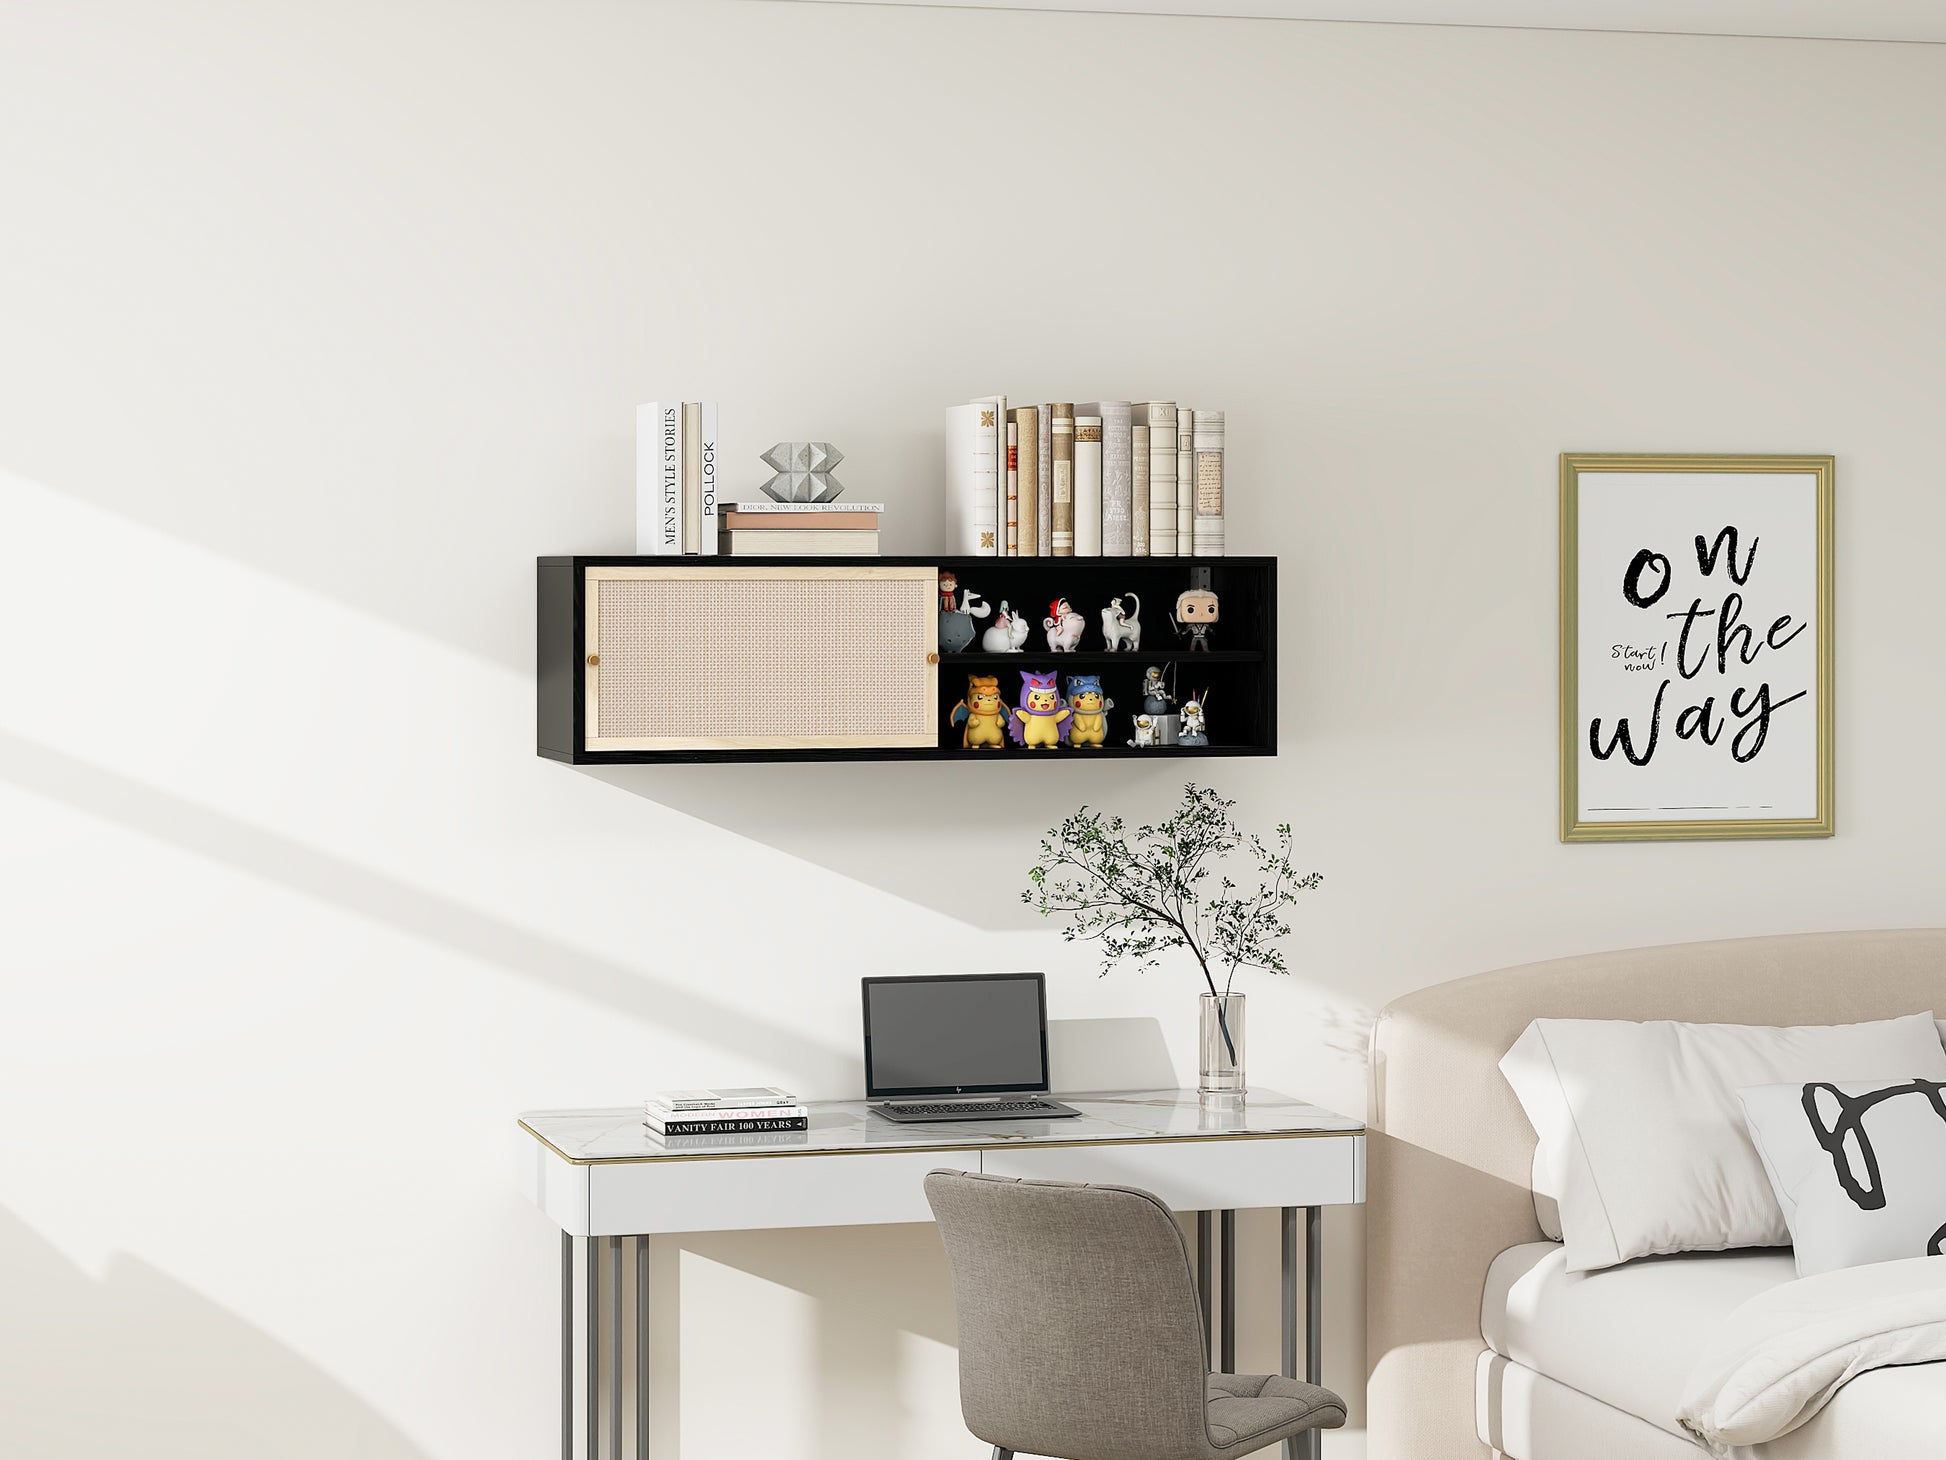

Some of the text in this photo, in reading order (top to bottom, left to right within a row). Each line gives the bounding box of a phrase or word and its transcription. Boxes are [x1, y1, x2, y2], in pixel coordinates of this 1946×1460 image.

[664, 408, 676, 545] MEN'S STYLE STORIES
[703, 441, 715, 516] POLLOCK
[1623, 525, 1760, 609] on
[1666, 592, 1808, 680] the
[667, 1120, 792, 1133] VANITY FAIR 100 YEARS
[718, 1109, 792, 1119] WOMEN
